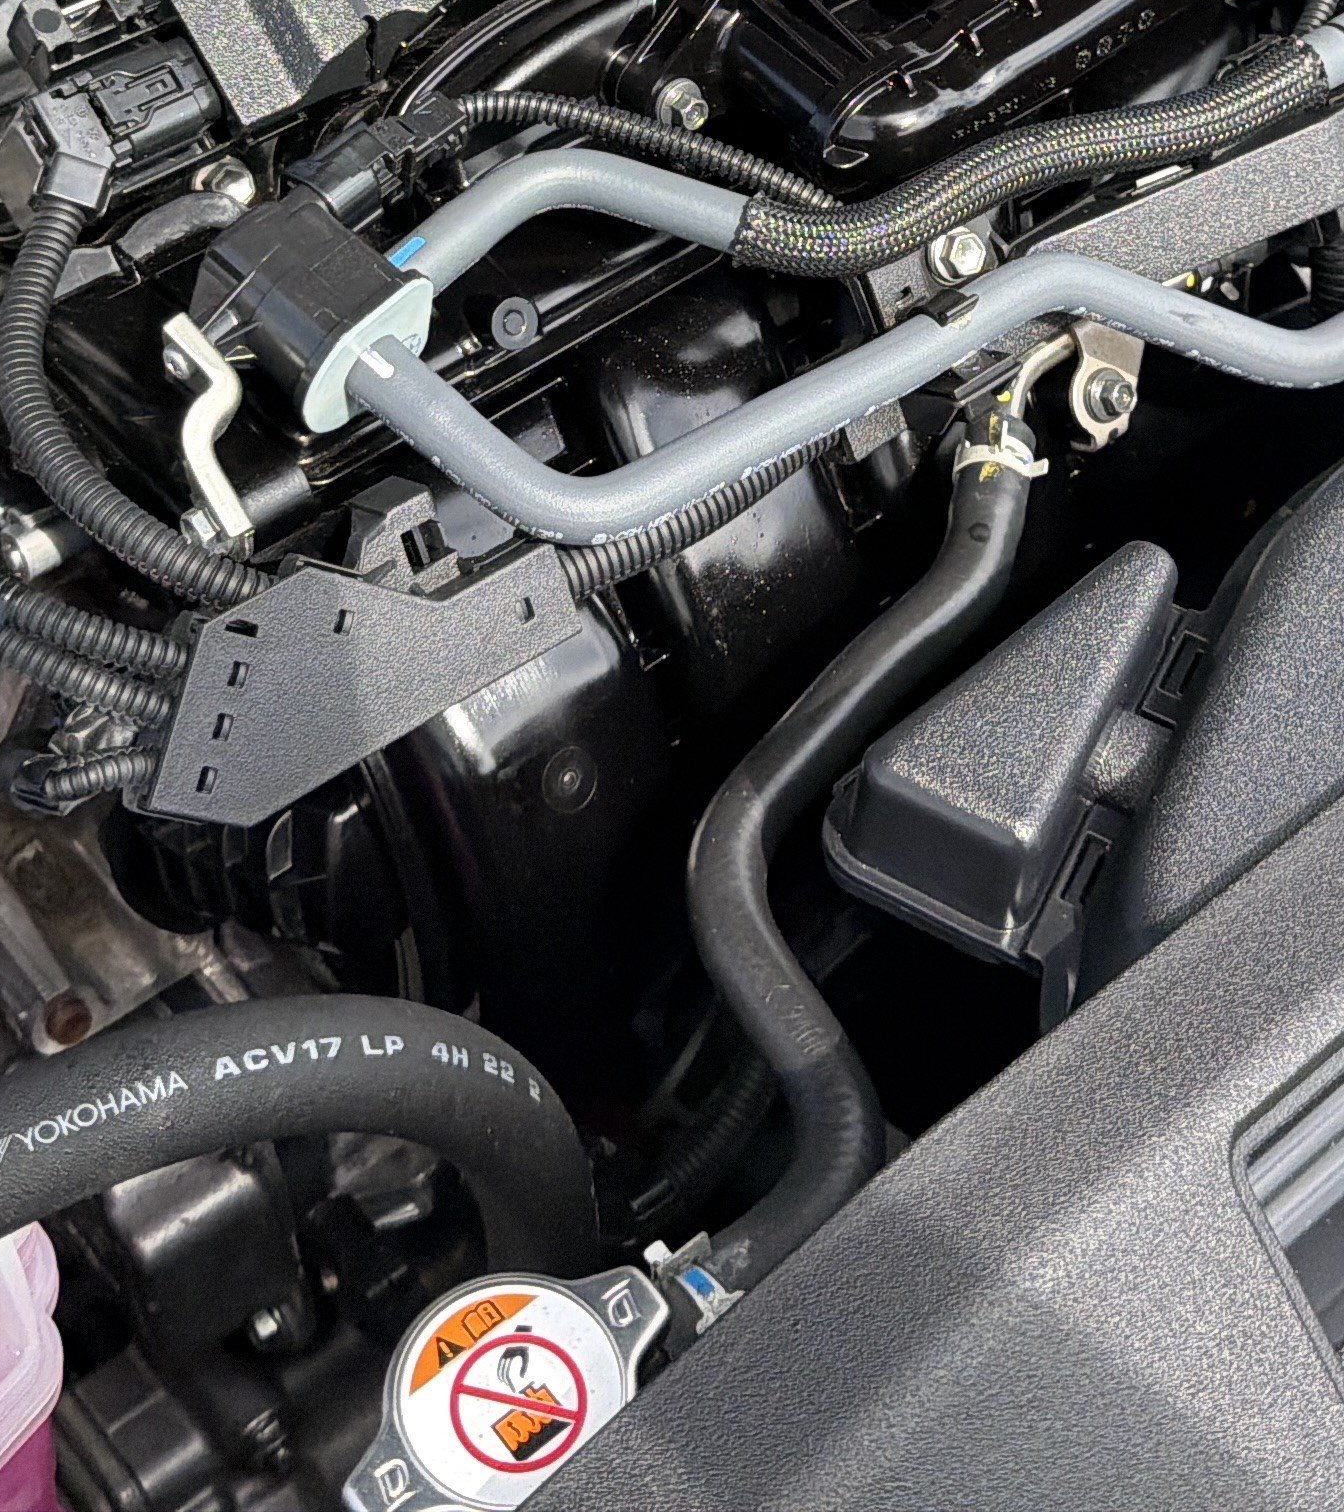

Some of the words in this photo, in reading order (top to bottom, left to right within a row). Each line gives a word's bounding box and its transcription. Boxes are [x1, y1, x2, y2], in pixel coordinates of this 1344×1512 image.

[13, 1071, 188, 1152] YOKOHAMA
[214, 1037, 342, 1080] ACV17
[361, 1035, 404, 1056] LP
[431, 1042, 469, 1068] 4H
[482, 1052, 515, 1084] 22
